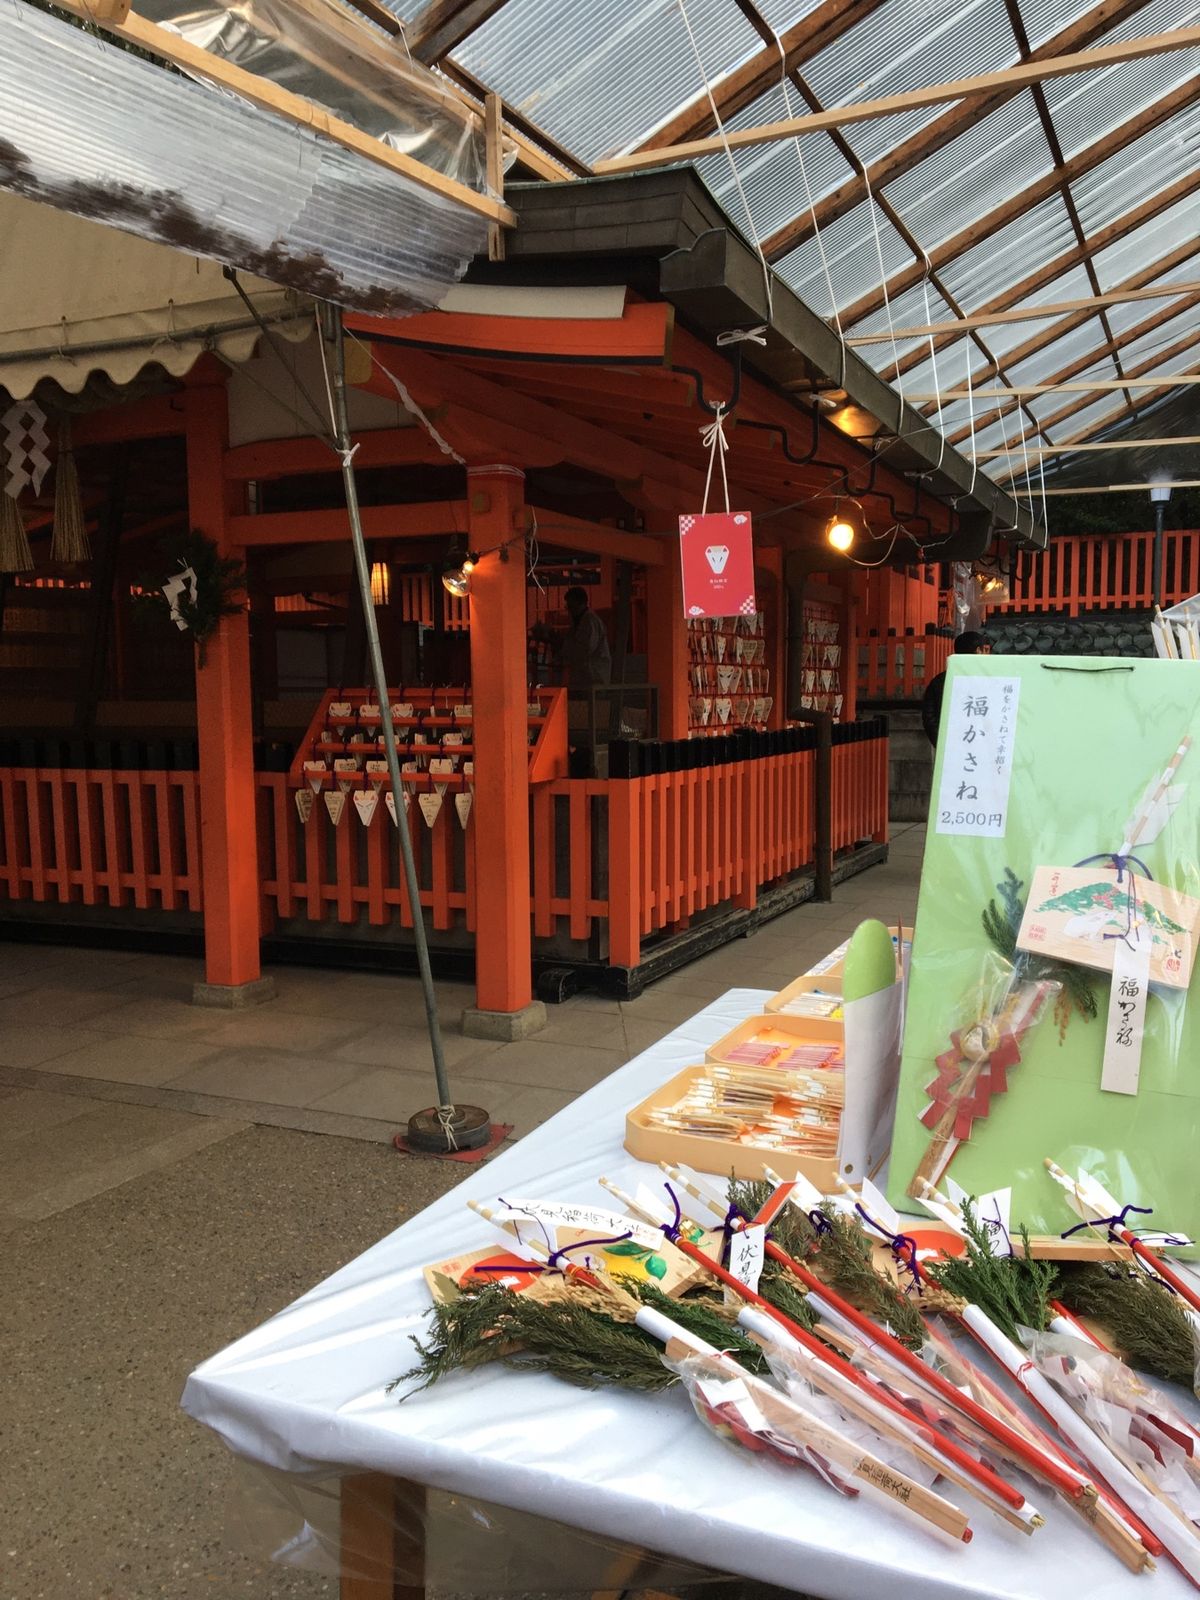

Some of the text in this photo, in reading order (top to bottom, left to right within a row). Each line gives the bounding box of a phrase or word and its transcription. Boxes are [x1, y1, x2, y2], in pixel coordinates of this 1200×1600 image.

[956, 696, 989, 800] 福かさね
[941, 811, 1003, 827] 2,500円
